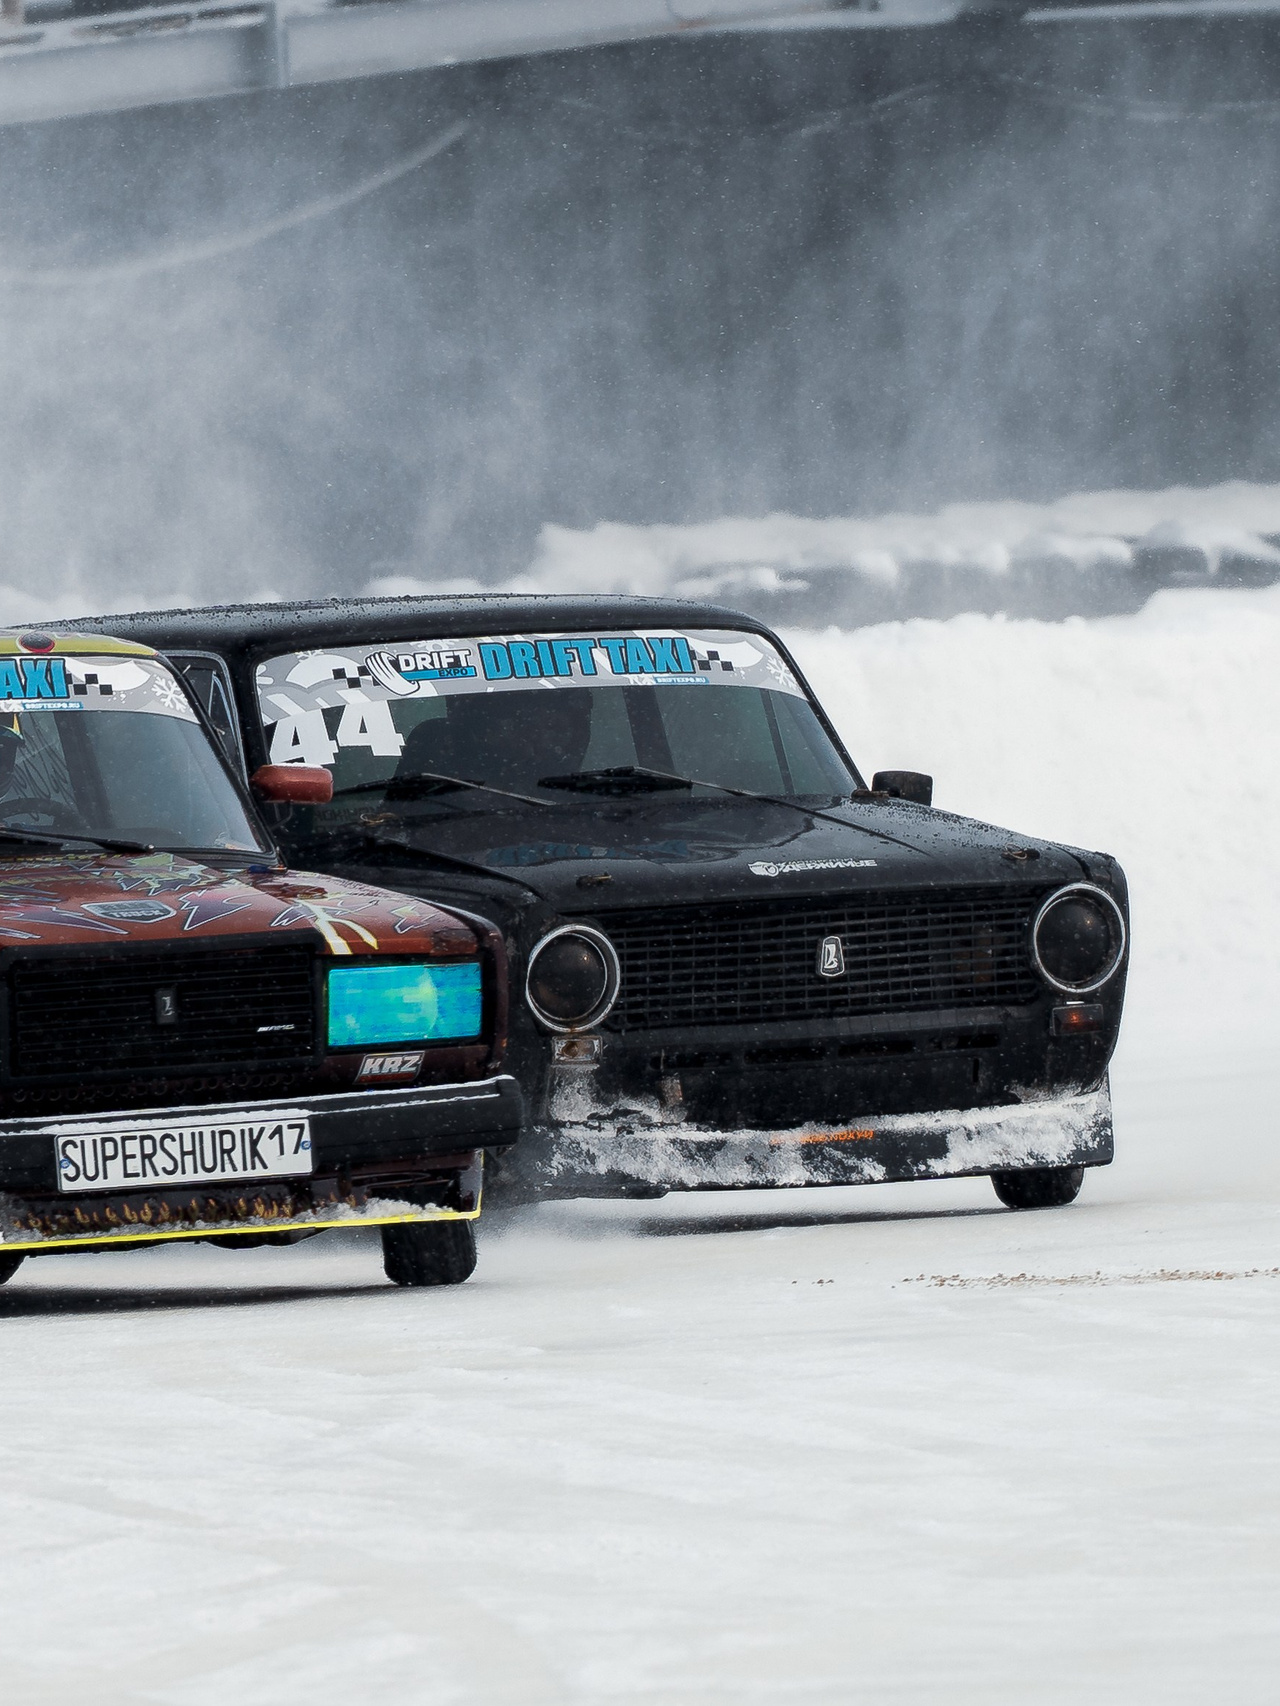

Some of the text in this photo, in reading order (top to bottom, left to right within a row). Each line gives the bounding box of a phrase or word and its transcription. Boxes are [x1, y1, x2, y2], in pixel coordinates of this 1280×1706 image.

[399, 649, 471, 671] DRIFT
[478, 637, 696, 680] DRIFT TAXI
[437, 667, 469, 678] EXPO
[269, 699, 404, 766] 44
[109, 910, 165, 918] TRUCK
[362, 1055, 423, 1075] KRZ
